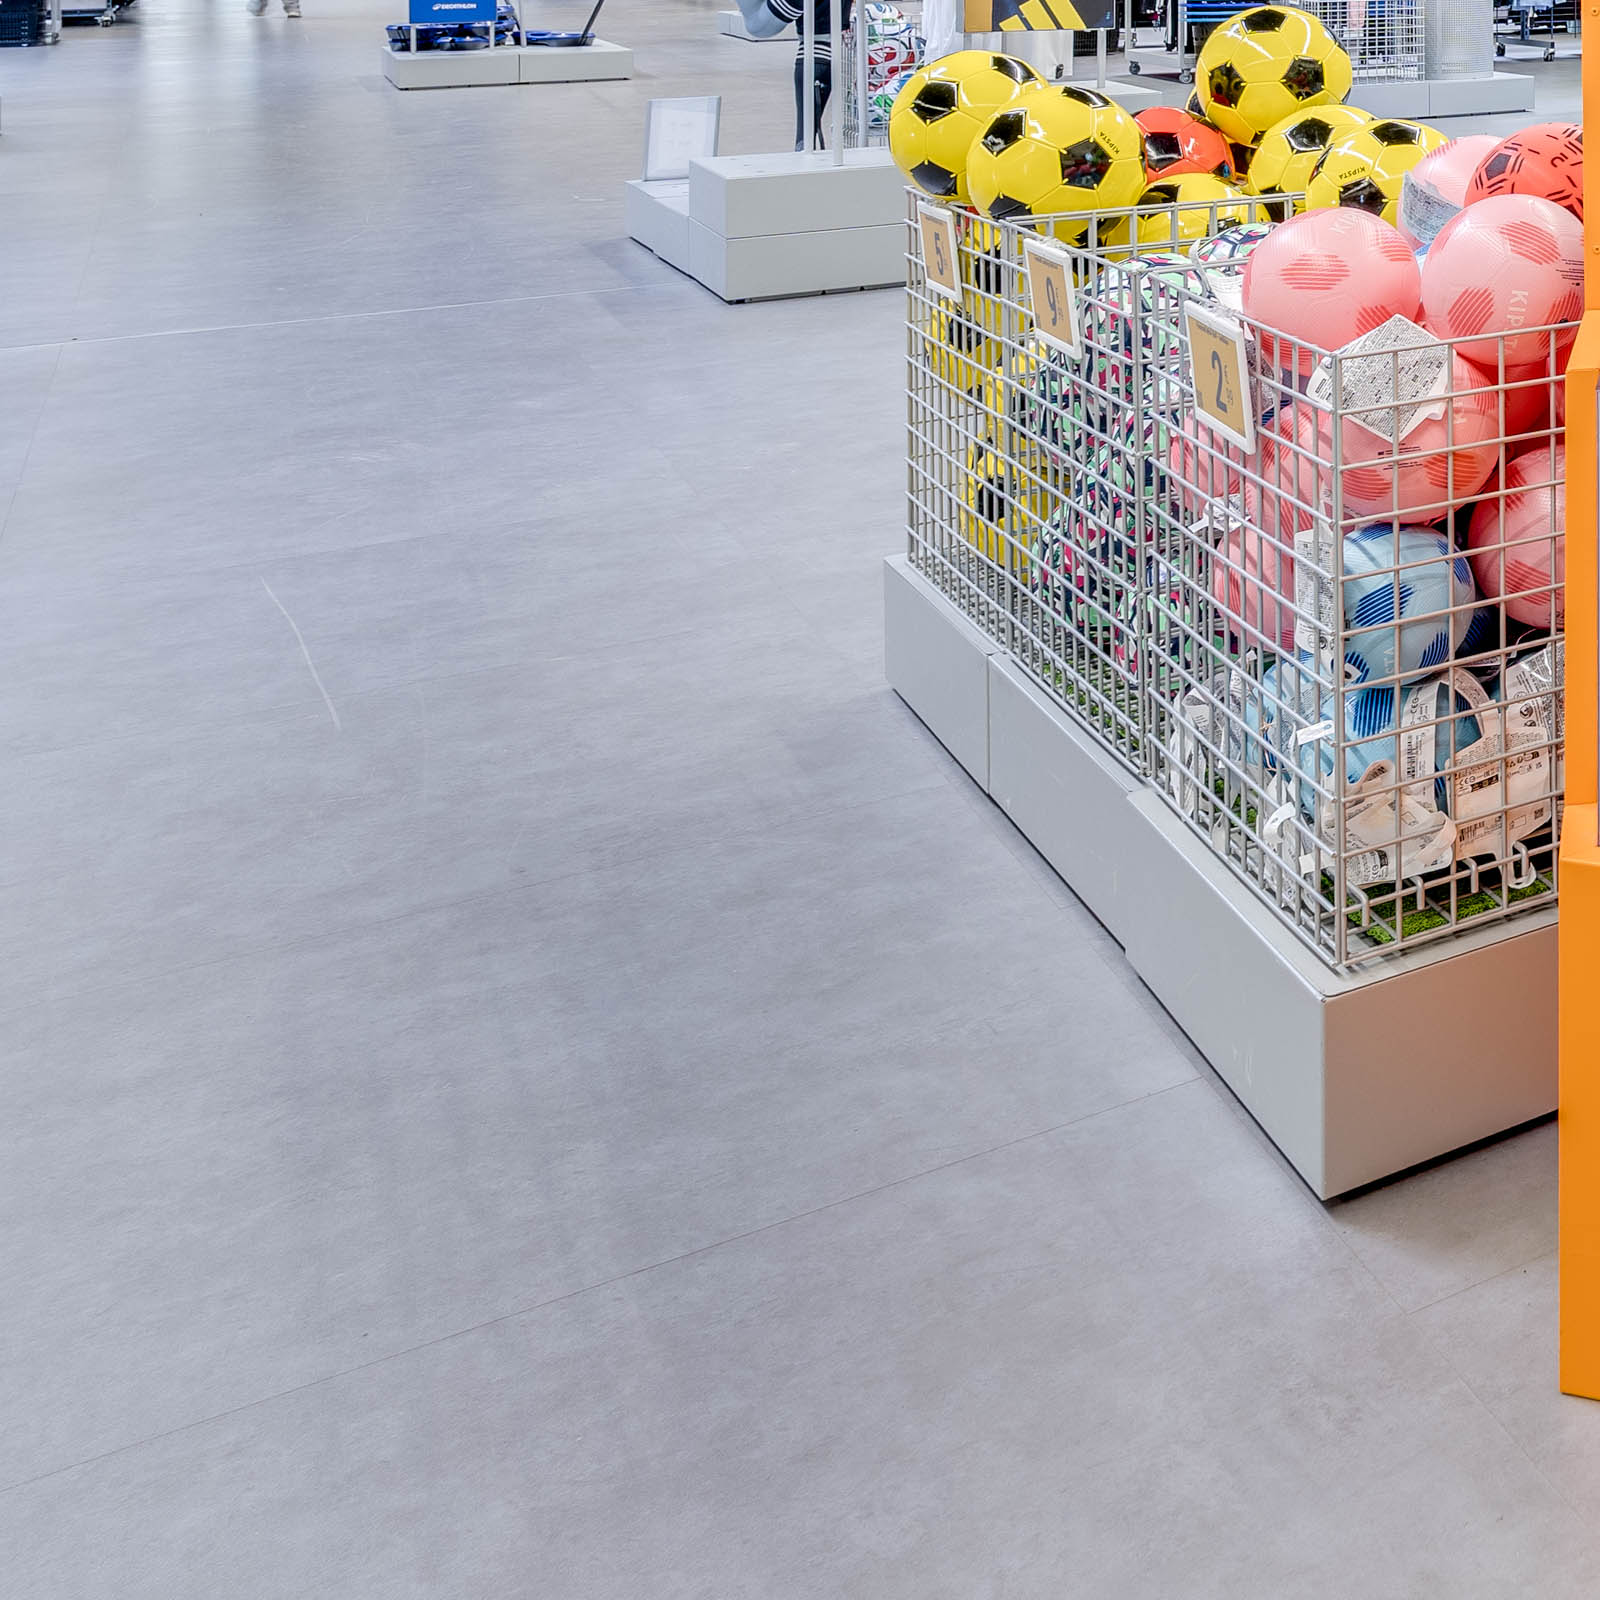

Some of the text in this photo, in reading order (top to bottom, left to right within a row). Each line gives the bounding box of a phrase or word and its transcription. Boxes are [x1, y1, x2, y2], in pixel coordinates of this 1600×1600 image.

[1339, 166, 1365, 180] KIPSTA
[934, 231, 944, 276] 5
[1046, 276, 1057, 326] 9
[1212, 350, 1228, 413] 2
